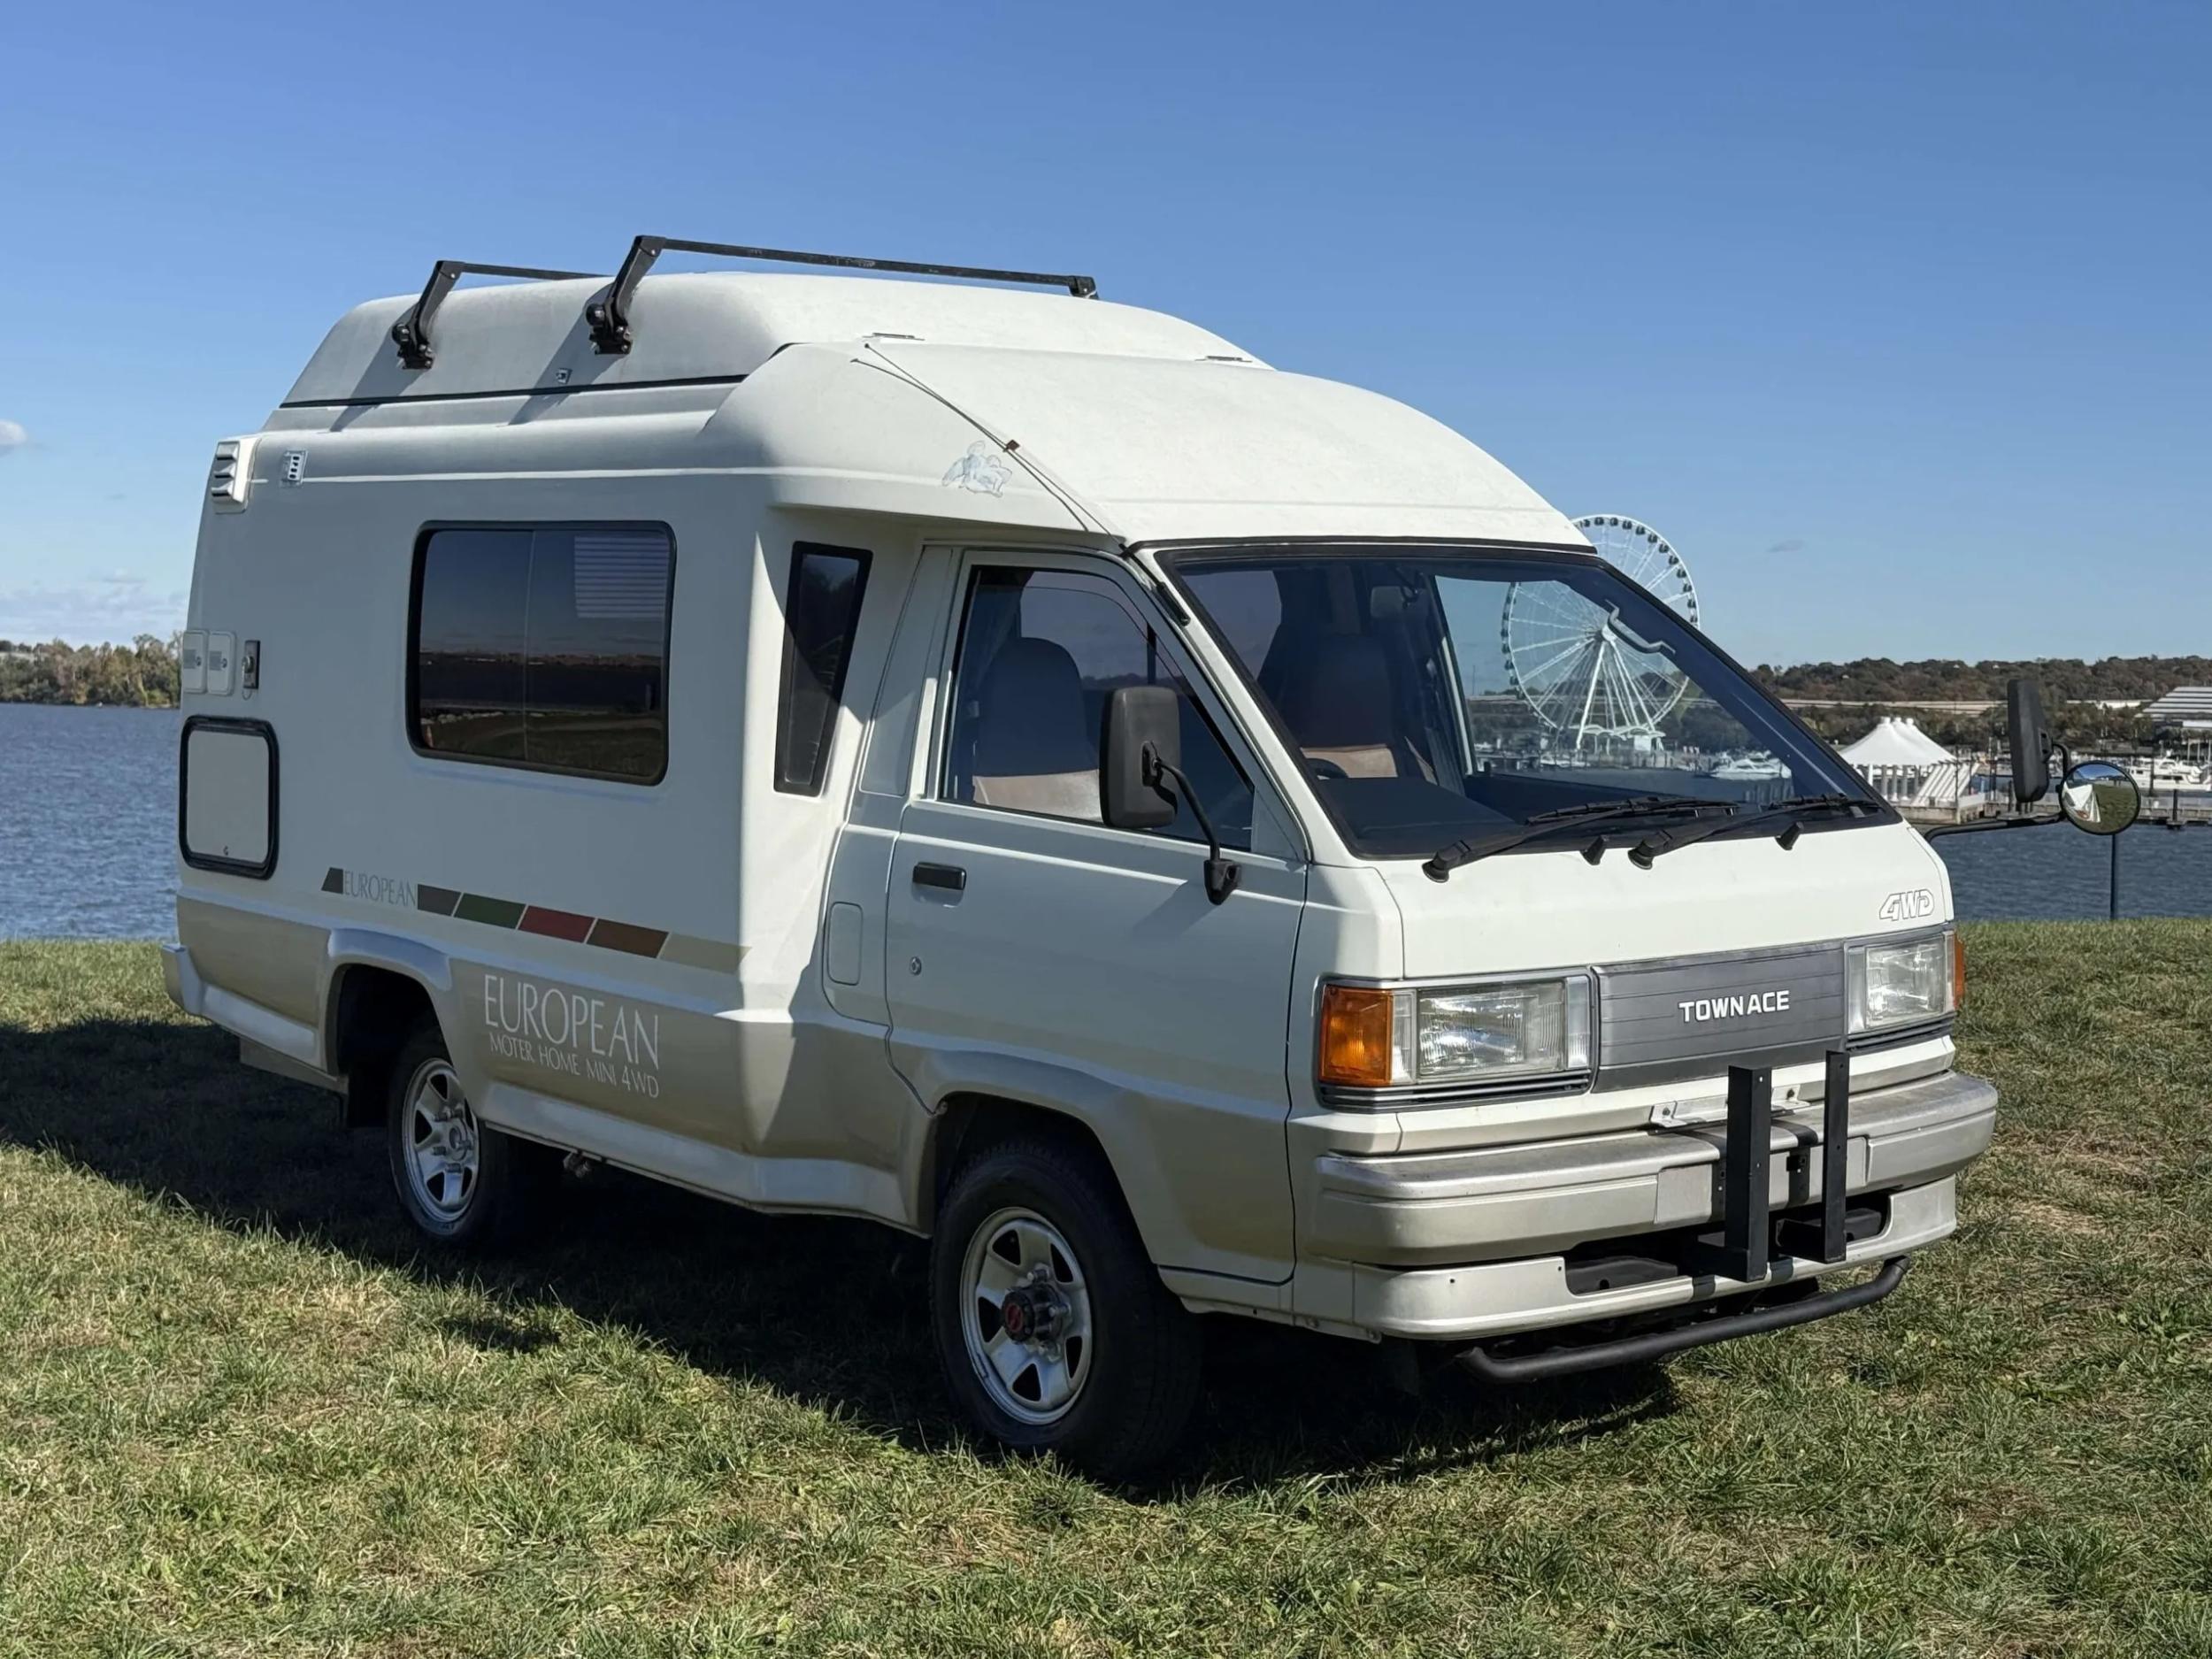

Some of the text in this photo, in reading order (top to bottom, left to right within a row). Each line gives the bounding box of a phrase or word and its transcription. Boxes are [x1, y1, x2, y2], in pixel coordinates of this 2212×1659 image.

[344, 871, 416, 906] EUROPEAN
[1879, 888, 1935, 921] 4WD
[485, 974, 659, 1070] EUROPEAN
[488, 1032, 659, 1098] MOTER HOME MINI 4WD
